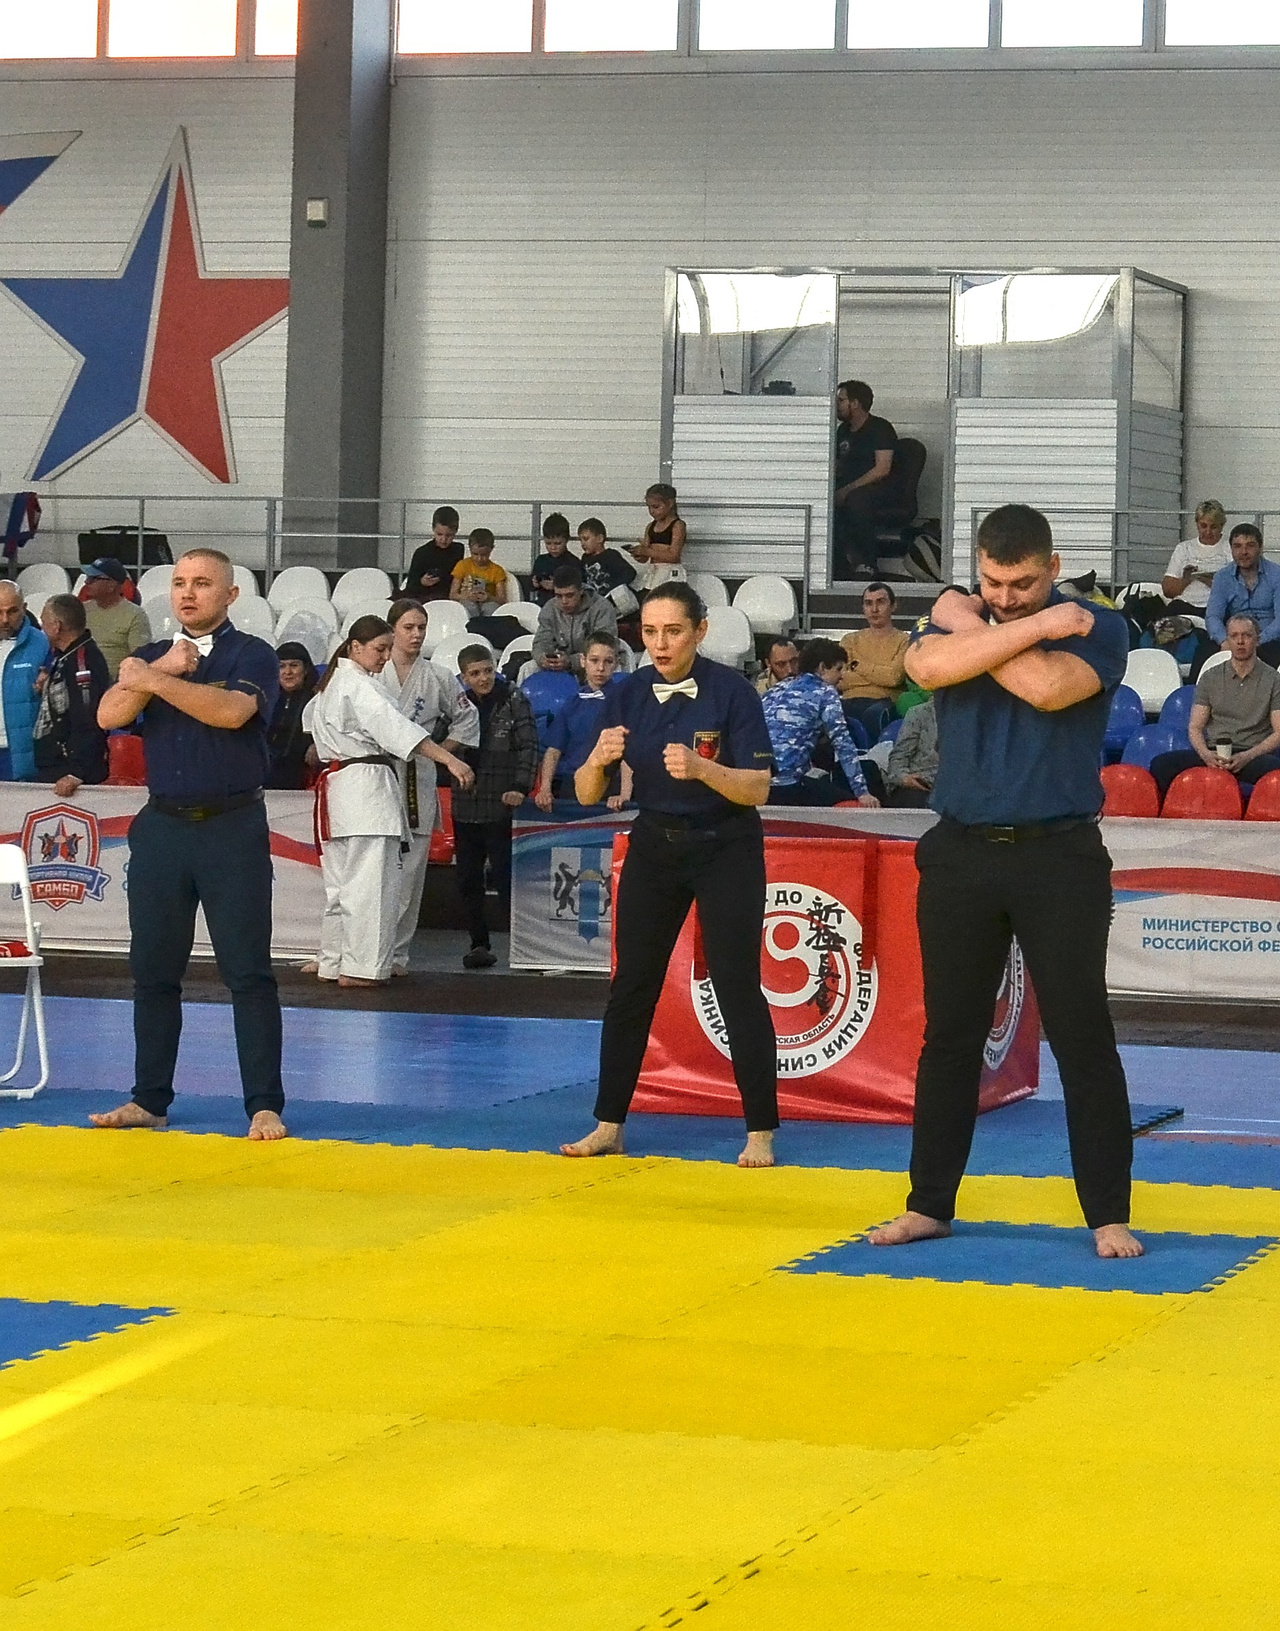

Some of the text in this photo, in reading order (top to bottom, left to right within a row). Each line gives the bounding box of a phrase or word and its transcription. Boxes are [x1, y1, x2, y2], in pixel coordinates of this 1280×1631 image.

[774, 889, 803, 906] ДО
[1142, 917, 1272, 933] МИНИСТЕРСТВО
[1142, 936, 1253, 952] РОССИЙСКОЙ
[803, 1013, 836, 1041] ОБЛАСТЬ
